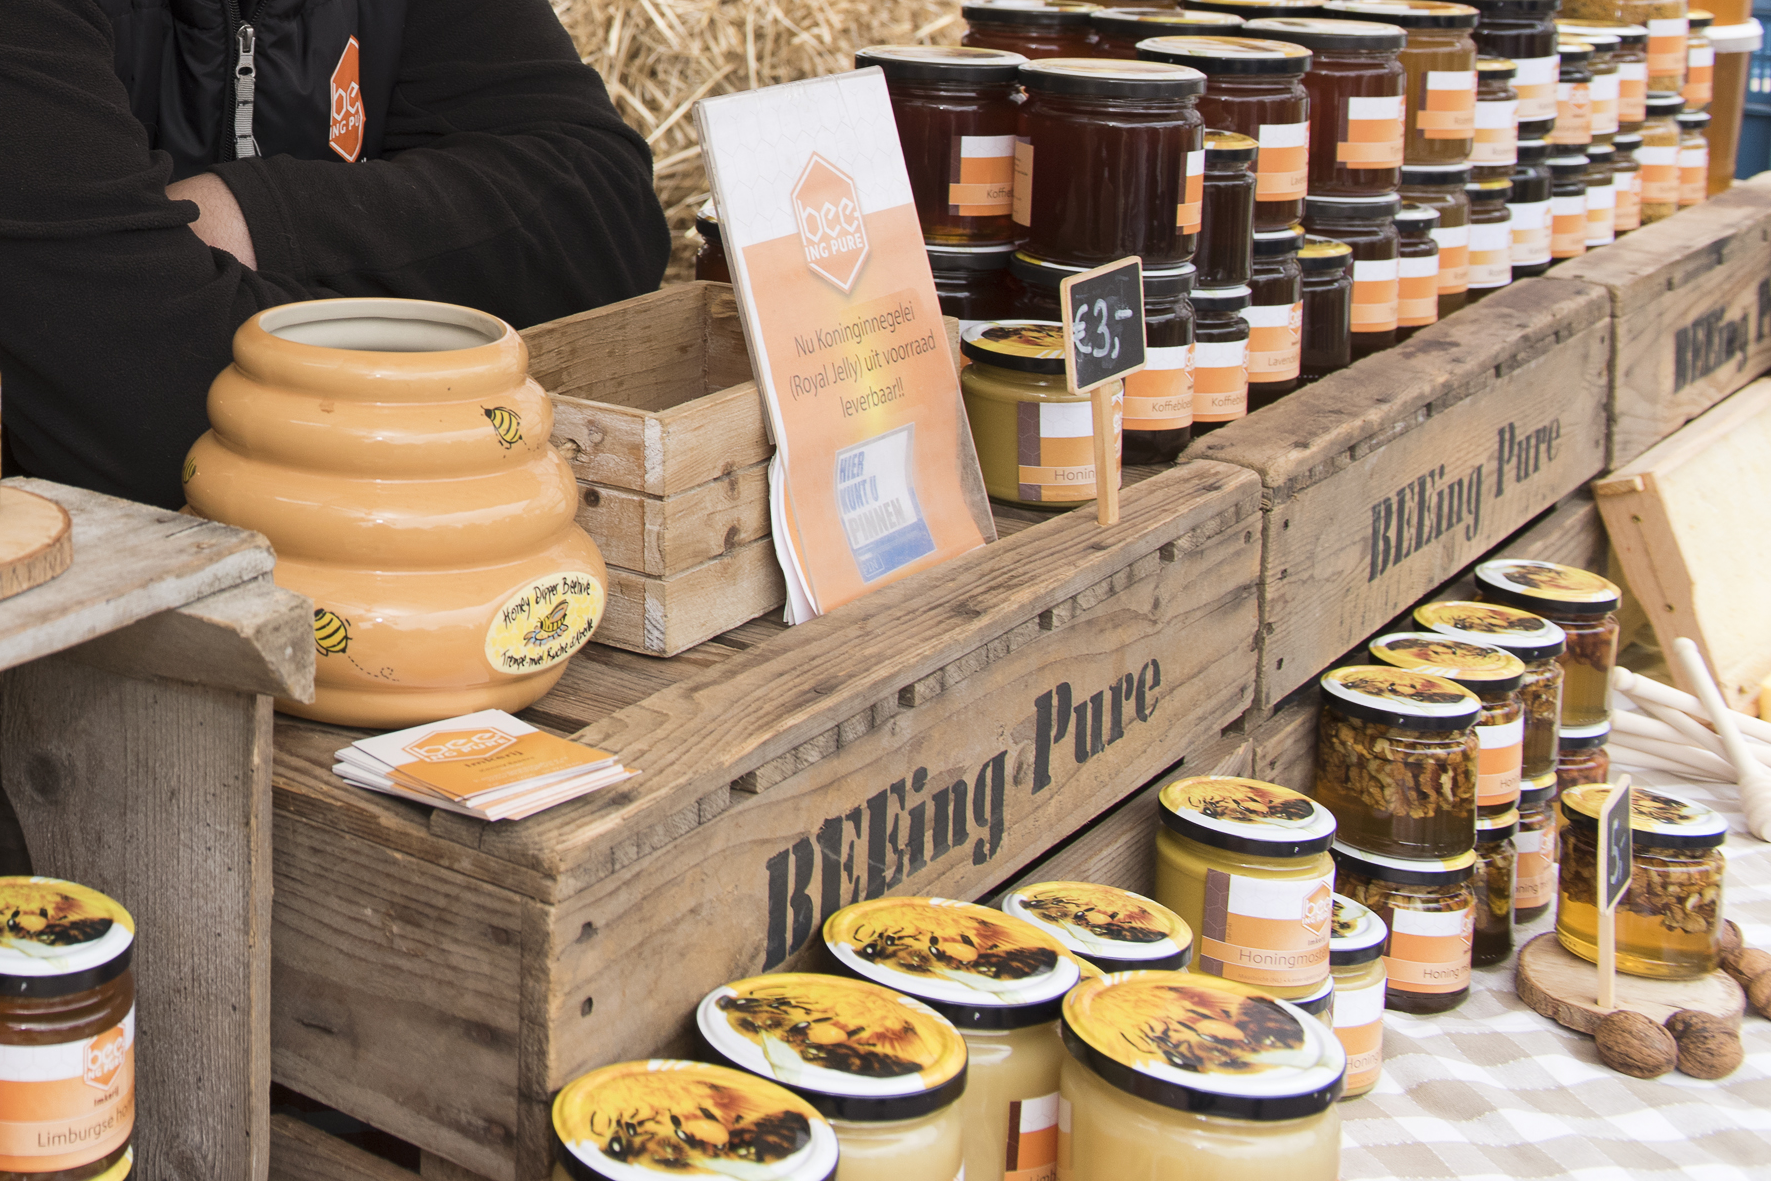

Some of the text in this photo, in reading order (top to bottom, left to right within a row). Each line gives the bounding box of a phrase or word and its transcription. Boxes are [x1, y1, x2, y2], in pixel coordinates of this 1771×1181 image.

[797, 197, 860, 243] bee
[804, 233, 864, 262] ING PURE
[794, 300, 916, 358] Nu Koninginnegelei
[789, 329, 937, 401] (Royal Jelly) uit voorraad
[839, 376, 905, 419] leverbaar!!
[839, 451, 865, 485] HIER
[1053, 468, 1096, 481] Honin
[839, 475, 879, 515] KUNT U
[1367, 417, 1561, 583] BEEing Pure
[847, 497, 906, 546] PINNEN
[502, 576, 591, 629] Honey Dipper Beehive
[761, 658, 1162, 973] BEEing Pure
[1423, 967, 1460, 979] Honing
[37, 1116, 114, 1148] Limburgse
